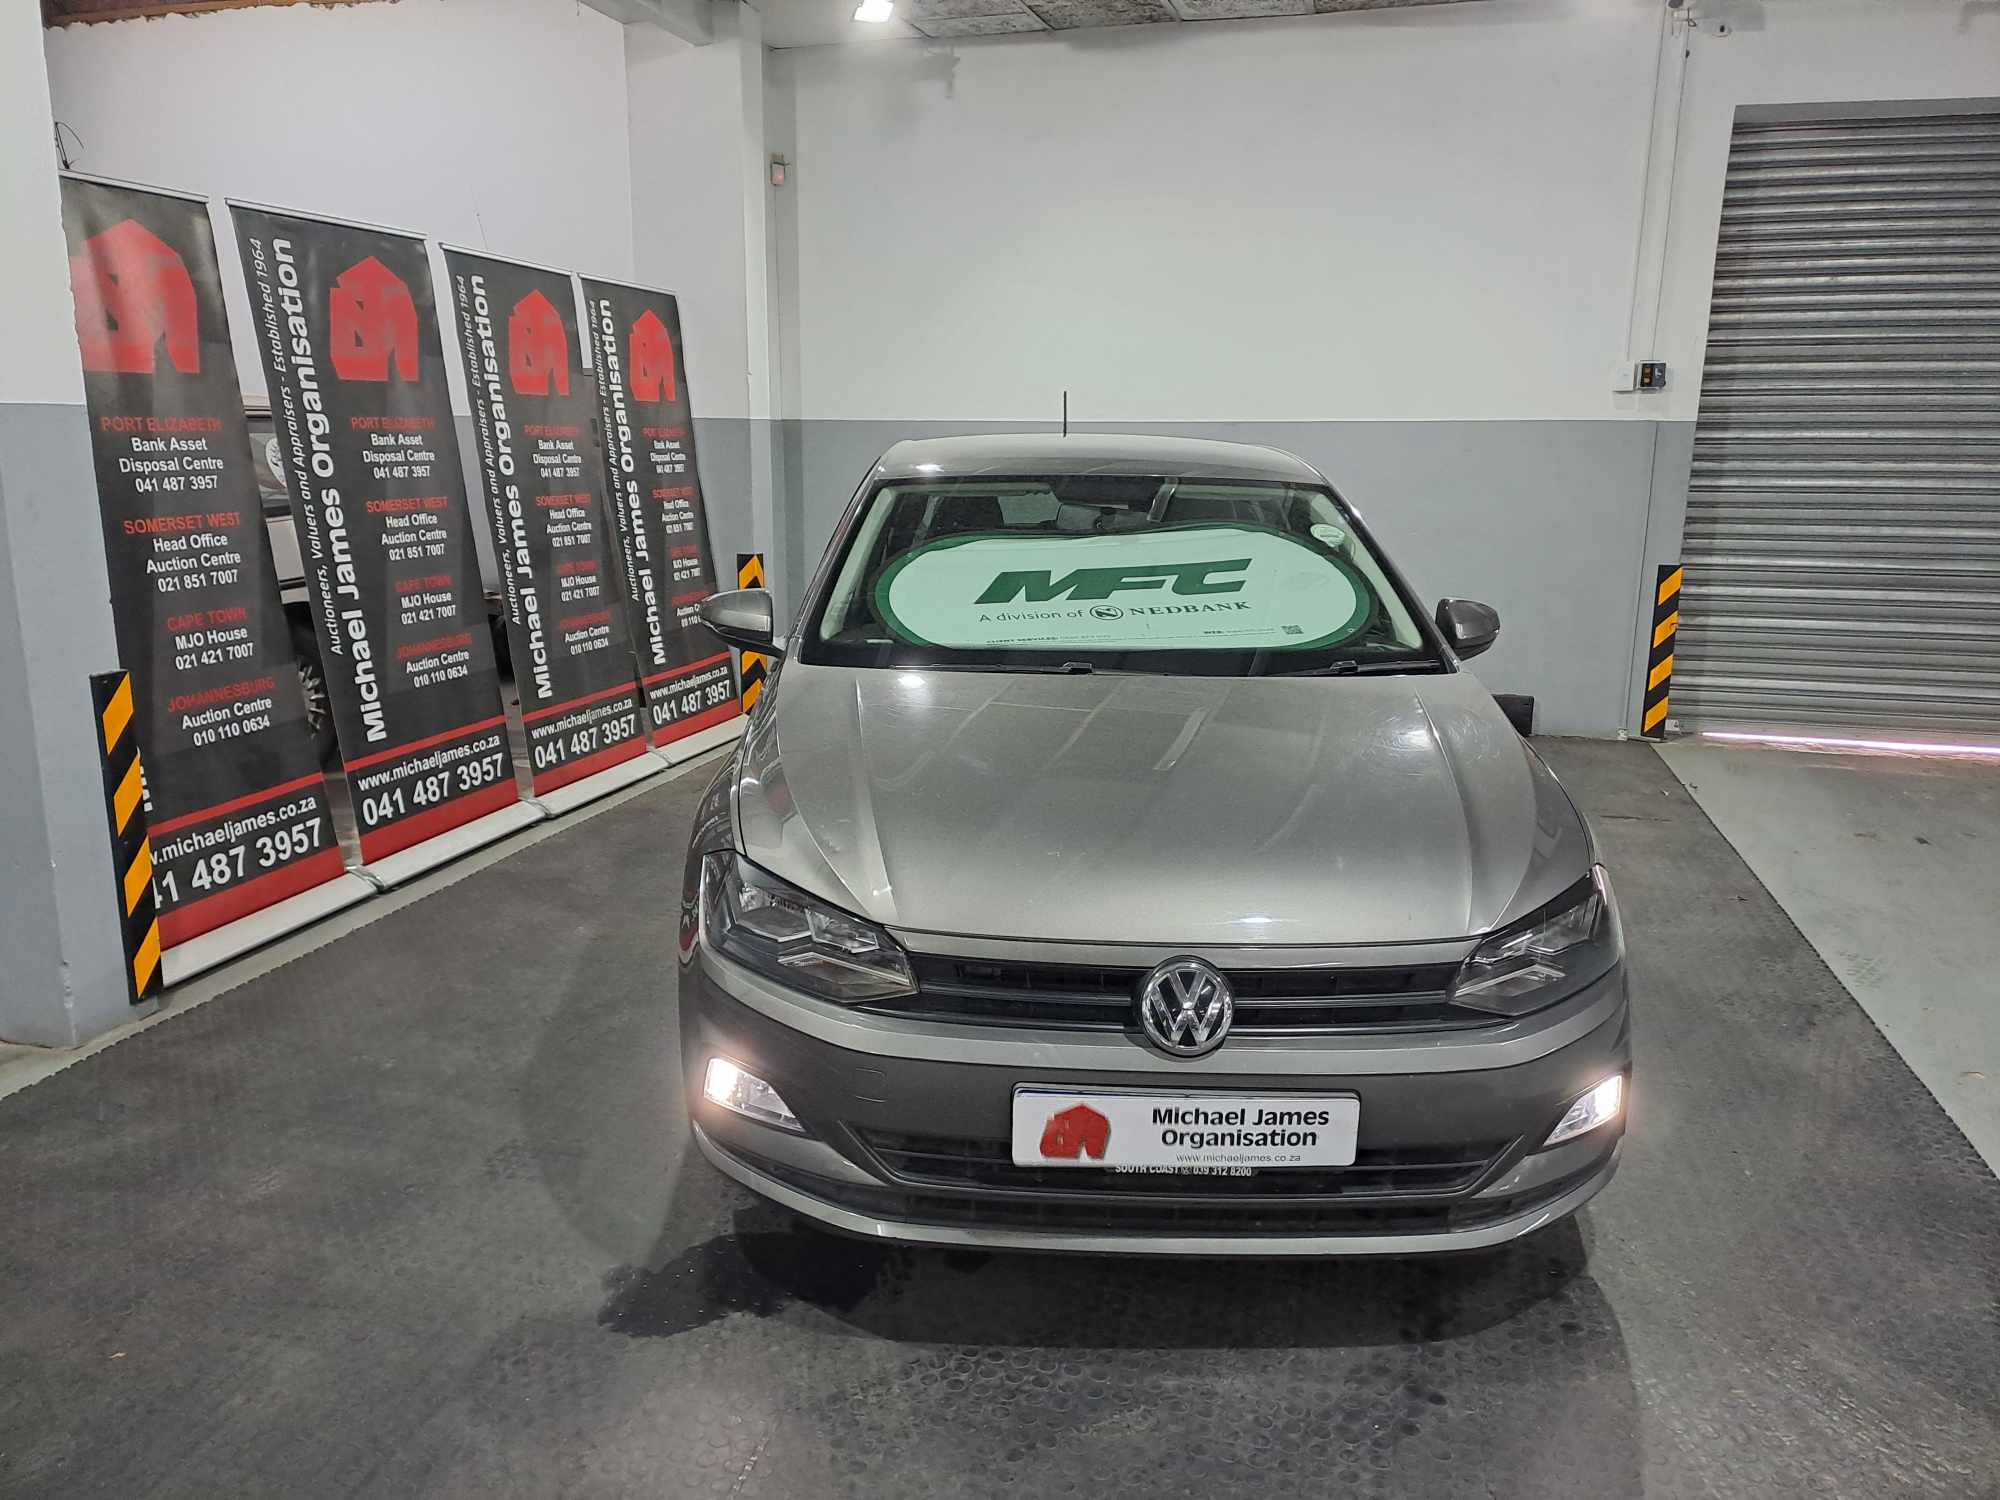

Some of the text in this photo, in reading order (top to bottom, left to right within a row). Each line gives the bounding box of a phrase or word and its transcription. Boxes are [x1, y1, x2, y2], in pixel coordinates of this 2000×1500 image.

[461, 311, 481, 387] Established
[101, 417, 142, 431] PORT
[476, 399, 495, 467] Appraisers
[131, 437, 207, 451] Bank Asset
[250, 238, 343, 655] Auctioneers, Valuers and Appraisers Established 1964
[370, 433, 423, 446] Bank Asset
[119, 456, 224, 474] Disposal Centre
[362, 450, 435, 464] Disposal Centre
[532, 453, 561, 466] Disposal
[136, 475, 218, 492] 041 487 3957
[373, 465, 430, 479] 041 487 3957
[486, 469, 500, 494] and
[600, 300, 666, 665] Michael James Organisation
[610, 467, 621, 489] and
[273, 238, 387, 743] Michael James Organisation
[471, 275, 553, 699] Michael James Organisation
[124, 512, 240, 534] SOMERSET WEST
[385, 513, 438, 528] Head Office
[492, 497, 507, 544] Valuers
[153, 533, 228, 552] Head Office
[381, 529, 448, 546] Auction Centre
[146, 552, 241, 574] Auction Centre
[389, 543, 445, 561] 021 851 7007
[157, 569, 238, 592] 021 851 7007
[973, 558, 1252, 605] MFC
[401, 592, 452, 609] MJO House
[980, 601, 1252, 623] A division of NEDBANK
[167, 612, 204, 631] CAPE
[401, 605, 456, 625] 021 421 7007
[175, 628, 248, 651] MJO House
[175, 642, 254, 670] 021 421 7007
[405, 650, 470, 674] Auction Centre
[413, 664, 468, 688] 010 110 0634
[650, 666, 728, 700] www.michaeljames.co.za
[182, 697, 272, 730] Auction Centre
[653, 680, 730, 725] 041 487 3957
[193, 714, 270, 746] 010 110 0634
[531, 698, 633, 740] www.michaeljames.co.za
[534, 713, 636, 769] 041 487 3957
[358, 735, 500, 792] www.michaeljames.co.za
[362, 752, 503, 827] 041 487 3957
[191, 845, 246, 891] 487
[255, 817, 321, 868] 3957
[1152, 1108, 1329, 1126] Michael James
[1161, 1129, 1318, 1149] Organisation
[1115, 1165, 1147, 1174] SOUTH
[1211, 1167, 1228, 1176] 312
[1230, 1167, 1252, 1177] 8200
